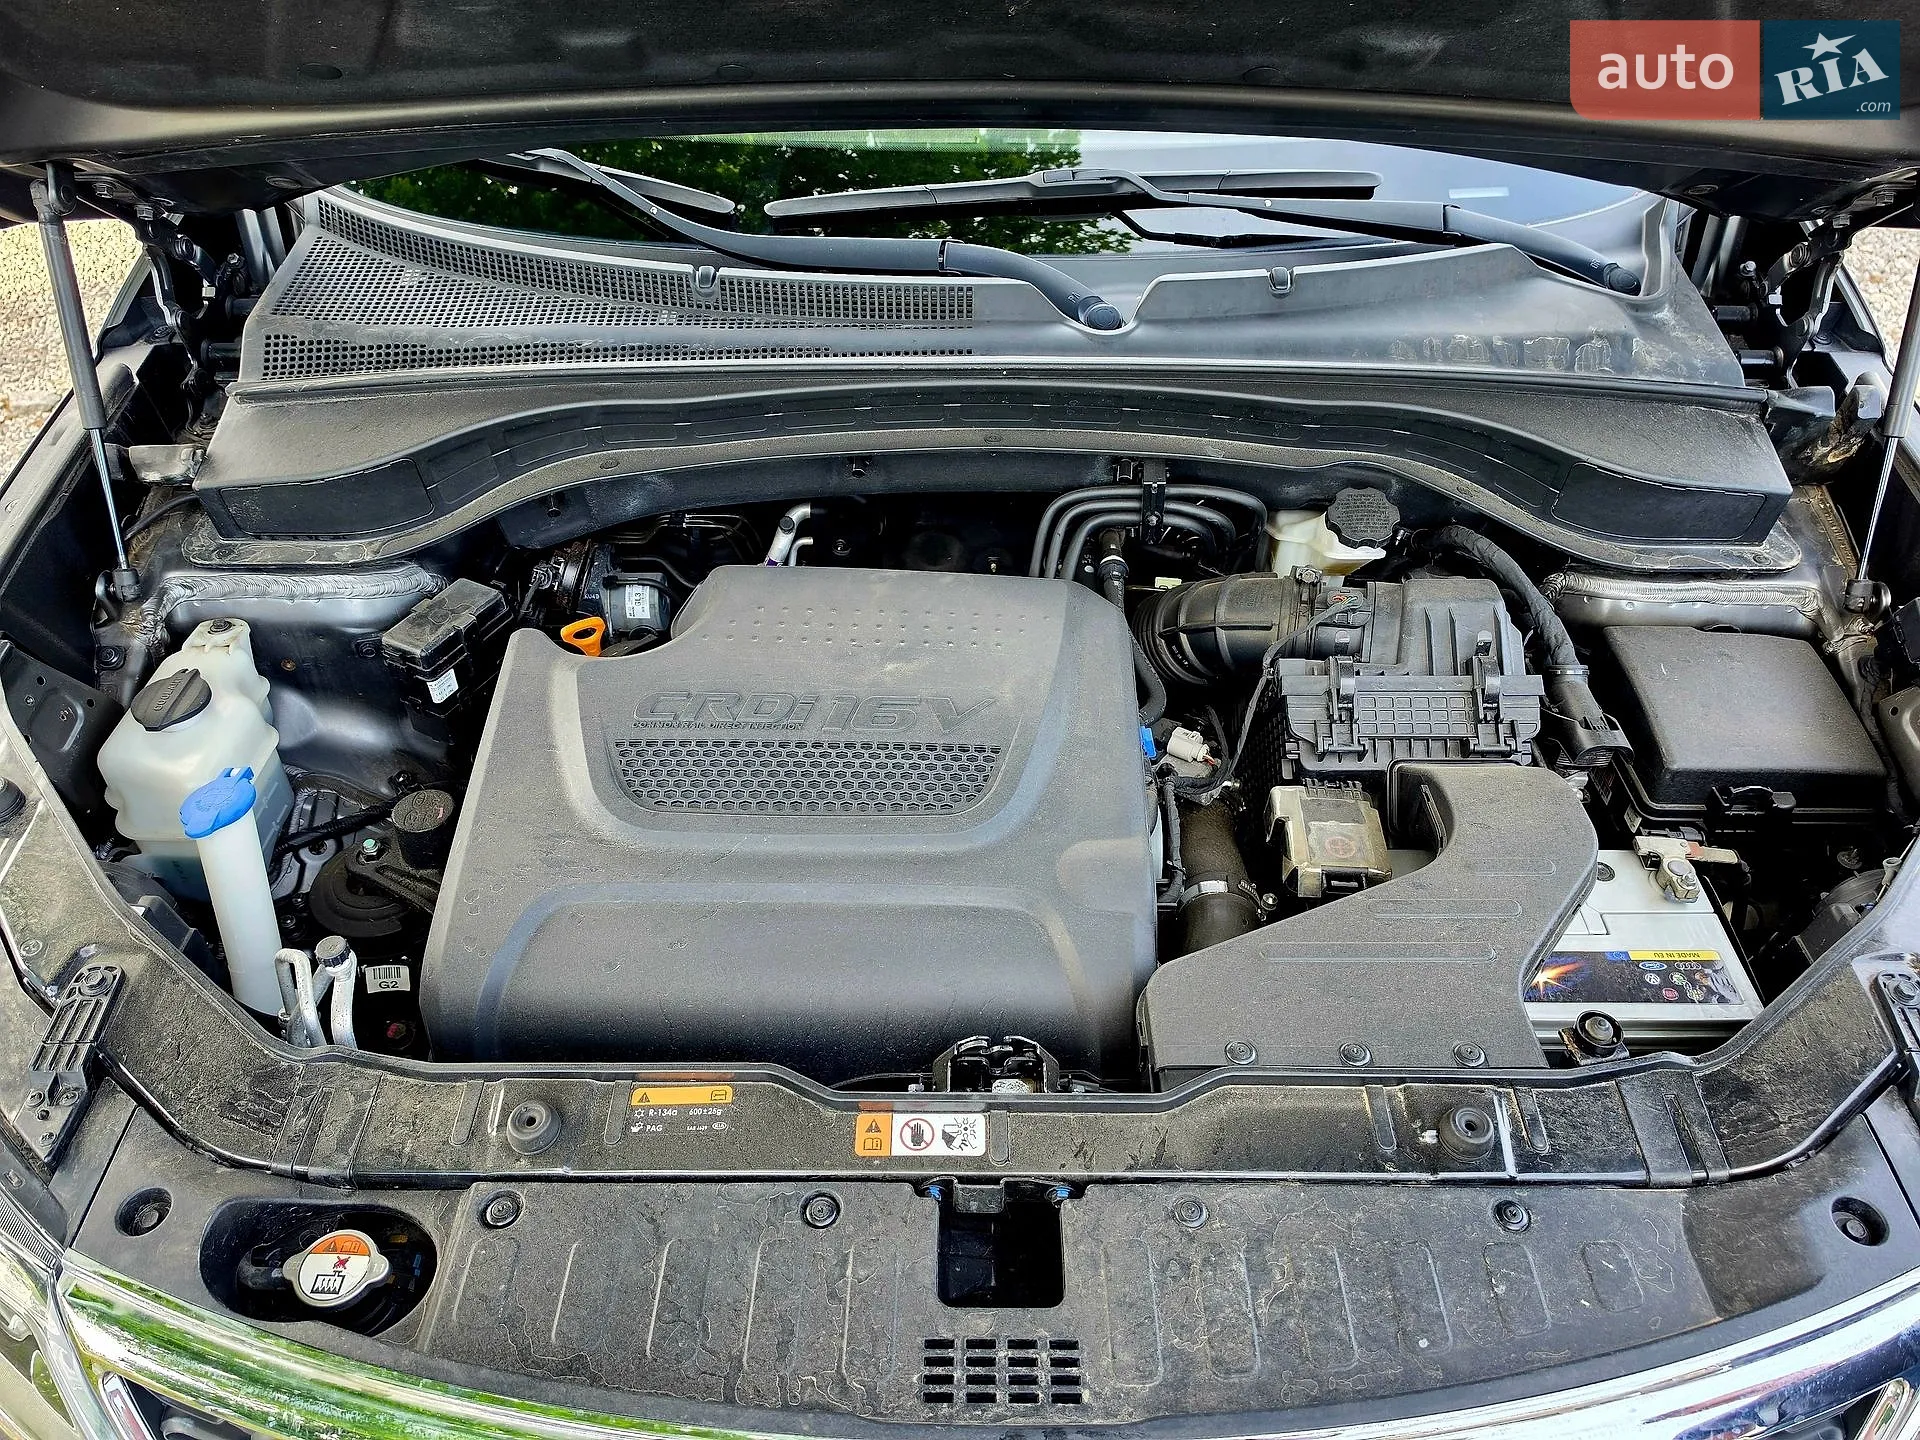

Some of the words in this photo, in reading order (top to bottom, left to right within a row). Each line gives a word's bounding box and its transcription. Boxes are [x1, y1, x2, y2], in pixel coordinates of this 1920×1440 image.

[634, 592, 642, 607] GL3
[378, 981, 399, 989] G2
[648, 1108, 678, 1116] R-134a
[646, 1124, 663, 1132] PAG
